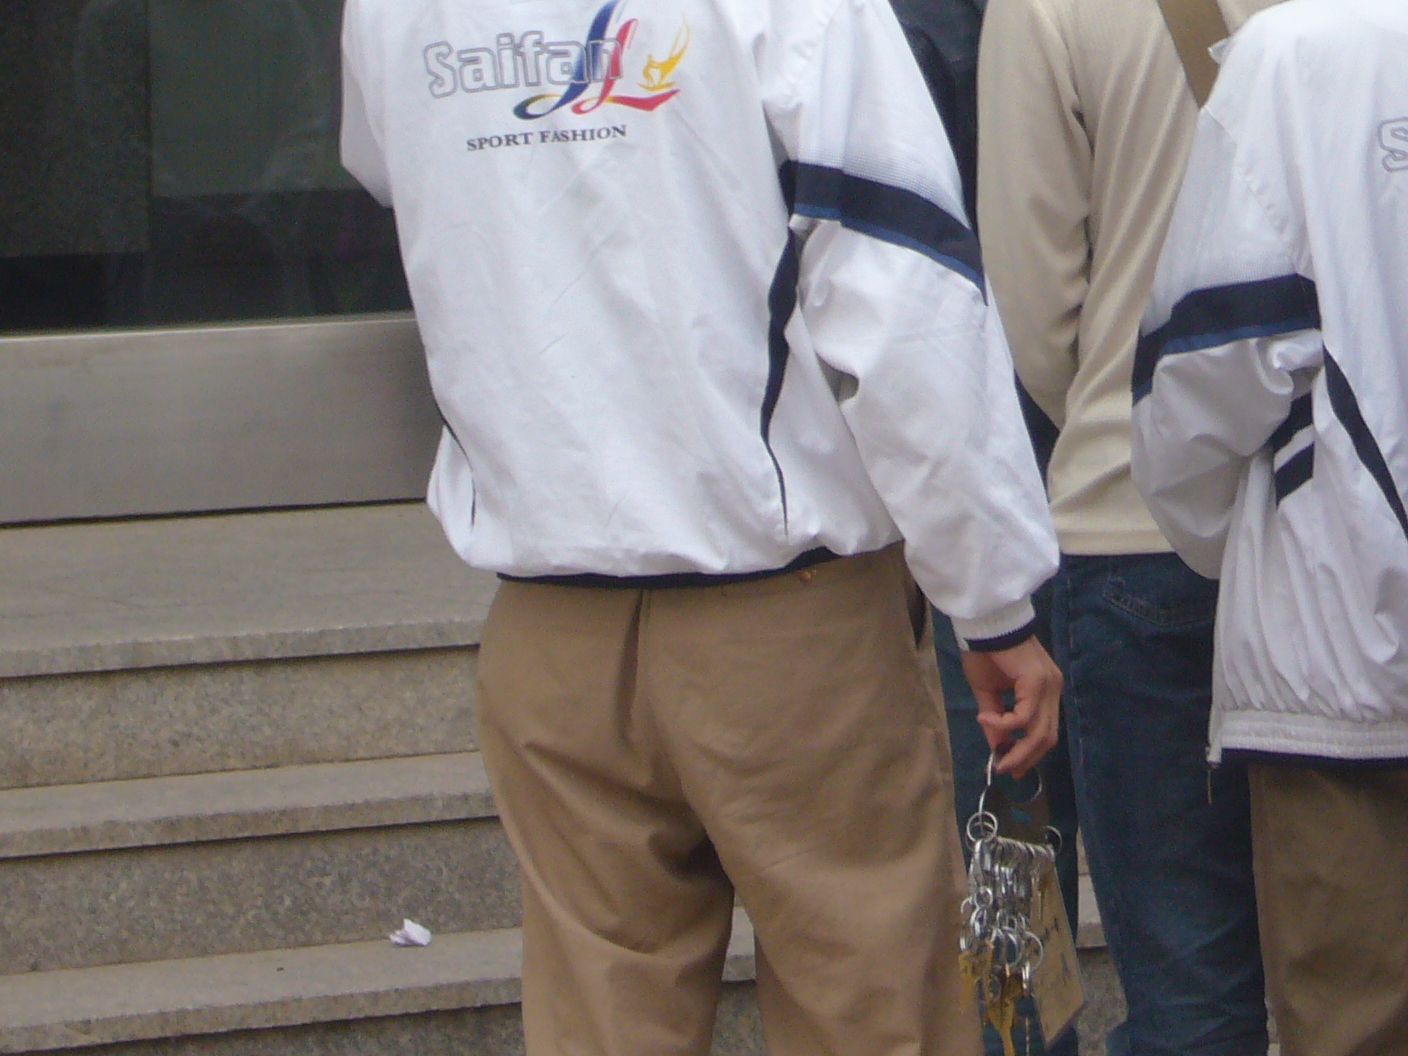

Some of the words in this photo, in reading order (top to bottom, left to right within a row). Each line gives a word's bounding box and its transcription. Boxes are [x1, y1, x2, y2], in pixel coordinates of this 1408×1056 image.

[424, 30, 623, 98] Saifan
[466, 132, 533, 151] SPORT
[539, 124, 628, 144] FASHION
